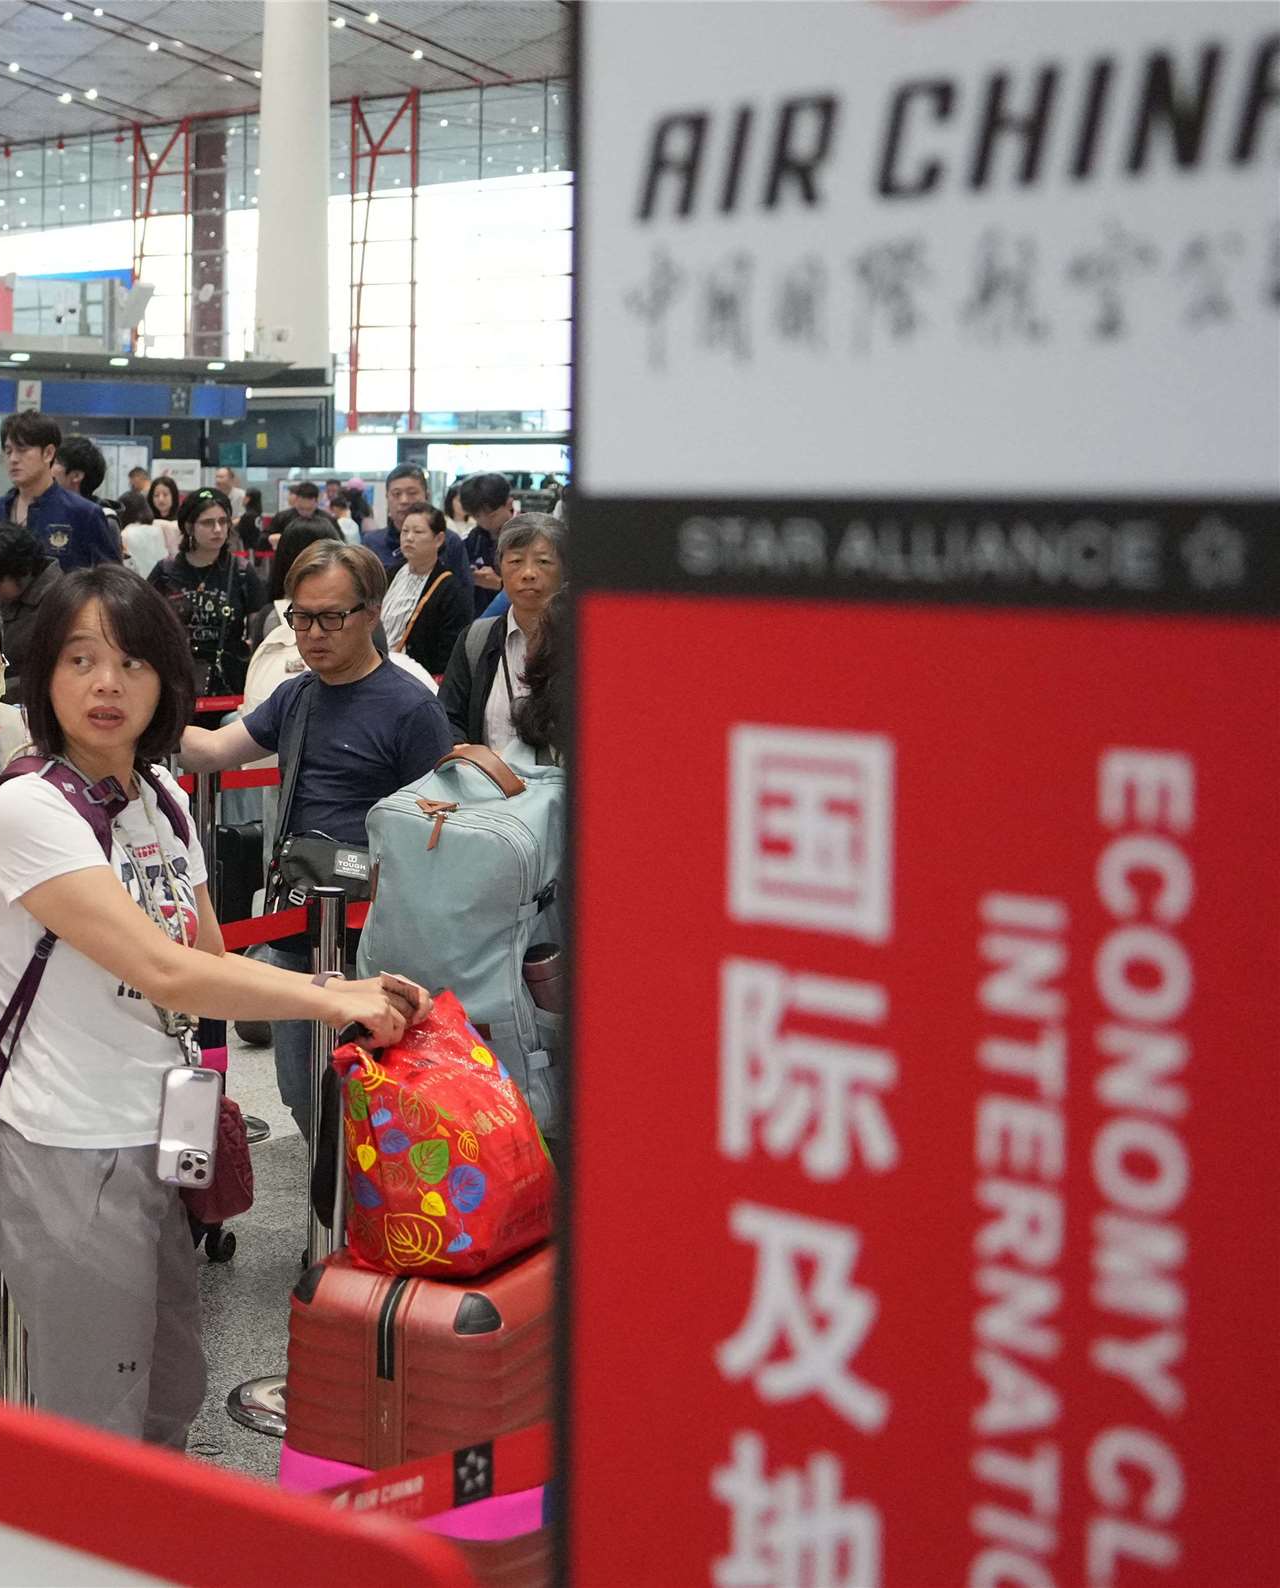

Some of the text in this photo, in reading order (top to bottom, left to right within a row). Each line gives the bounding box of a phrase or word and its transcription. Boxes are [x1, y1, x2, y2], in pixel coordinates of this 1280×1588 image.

[634, 90, 839, 225] AIR
[677, 514, 1163, 590] STAR ALLIANCE
[337, 860, 366, 870] TOUGH
[1086, 745, 1197, 1414] ECONOMY
